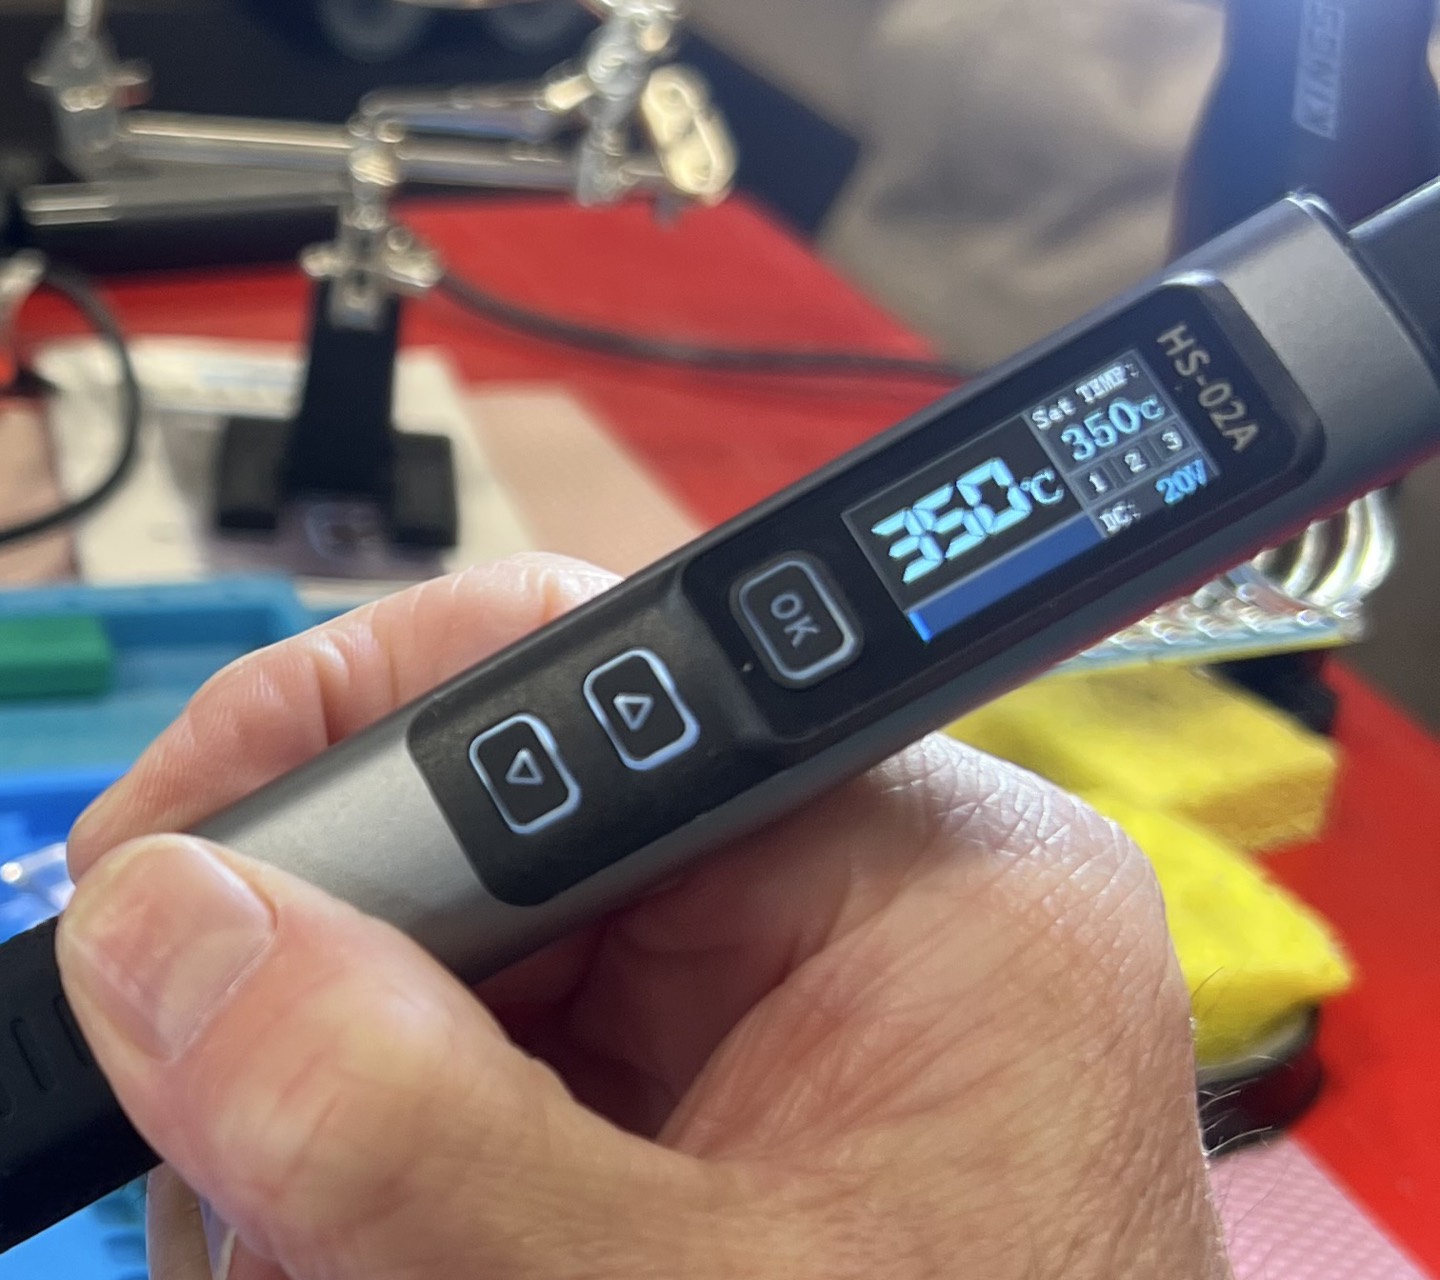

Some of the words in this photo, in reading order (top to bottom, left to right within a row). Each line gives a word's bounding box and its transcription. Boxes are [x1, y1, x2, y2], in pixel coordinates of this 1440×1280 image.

[1032, 397, 1076, 430] Set
[1157, 324, 1258, 452] HS-02A
[1089, 471, 1108, 493] 1
[1124, 448, 1146, 473] 2
[1162, 429, 1183, 452] 3
[1155, 458, 1208, 506] 20V
[770, 591, 819, 649] OK
